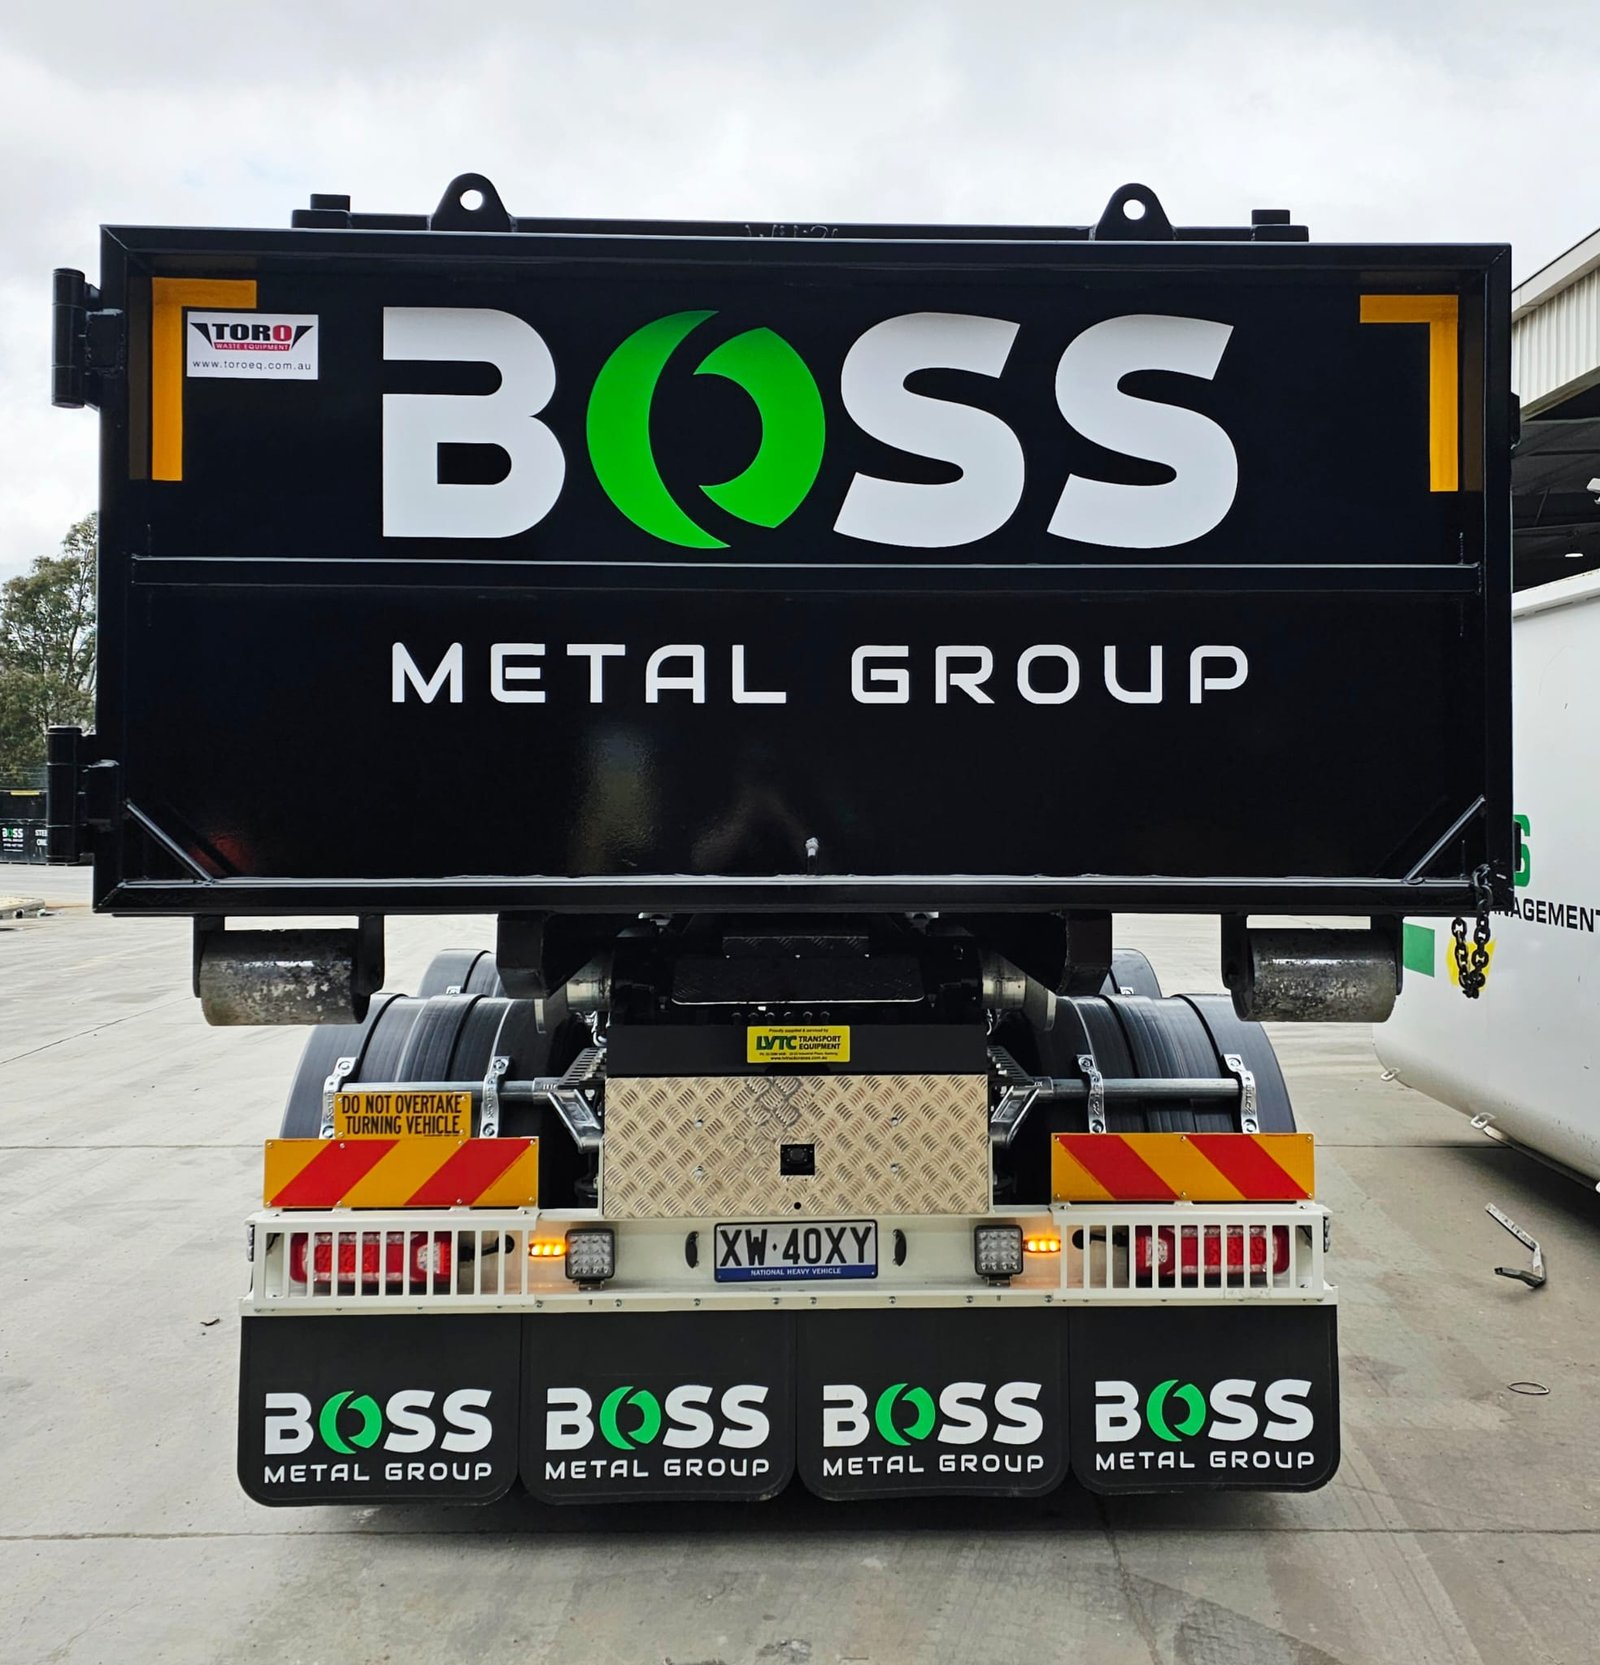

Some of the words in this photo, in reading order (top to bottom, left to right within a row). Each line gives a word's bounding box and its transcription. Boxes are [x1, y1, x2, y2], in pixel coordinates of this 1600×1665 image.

[212, 323, 292, 342] TORO
[243, 343, 289, 351] EQUIPMENT
[192, 360, 311, 371] www.toroeq.com.au
[383, 307, 1239, 549] BOSS
[392, 642, 786, 704] METAL
[851, 644, 1249, 704] GROUP
[756, 1035, 797, 1050] LVTC
[342, 1095, 360, 1114] DO
[365, 1095, 392, 1114] NOT
[395, 1095, 462, 1114] OVERTAKE
[346, 1116, 401, 1135] TURNING
[406, 1115, 460, 1134] VEHICLE
[751, 1268, 785, 1276] NATIONAL
[787, 1268, 810, 1276] HEAVY
[812, 1267, 841, 1275] VEHICLE
[265, 1389, 493, 1454] BOSS
[546, 1385, 770, 1450] BOSS
[824, 1382, 1044, 1447] BOSS
[1095, 1379, 1314, 1442] BOSS
[546, 1460, 649, 1480] METAL
[664, 1458, 770, 1477] GROUP
[824, 1456, 925, 1476] METAL
[940, 1454, 1044, 1473] GROUP
[1095, 1451, 1195, 1471] METAL
[1210, 1450, 1315, 1469] GROUP
[265, 1465, 370, 1484] METAL
[385, 1462, 492, 1481] GROUP
